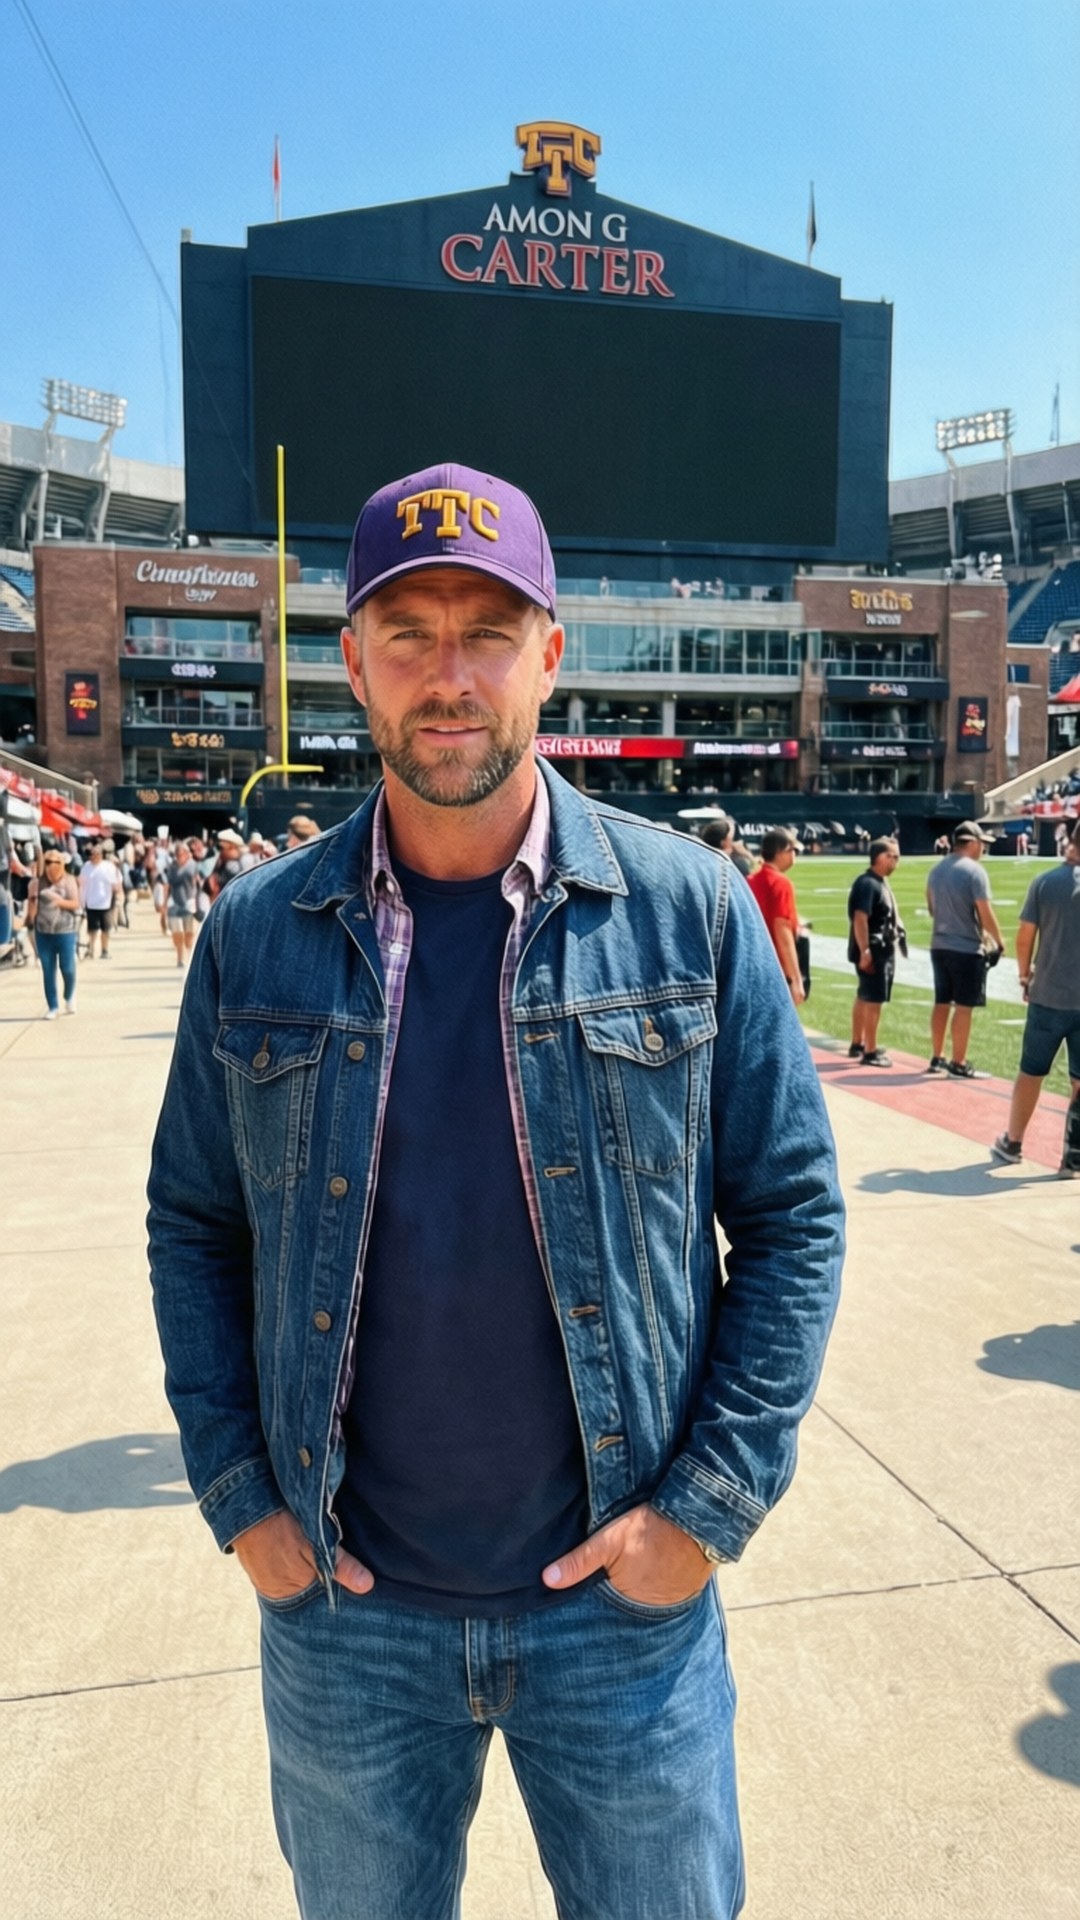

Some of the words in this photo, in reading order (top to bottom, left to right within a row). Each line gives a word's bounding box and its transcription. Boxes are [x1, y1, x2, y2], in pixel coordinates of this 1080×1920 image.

[483, 202, 592, 240] AMON
[601, 212, 629, 243] G
[441, 233, 676, 299] CARTER
[396, 488, 501, 542] TTC
